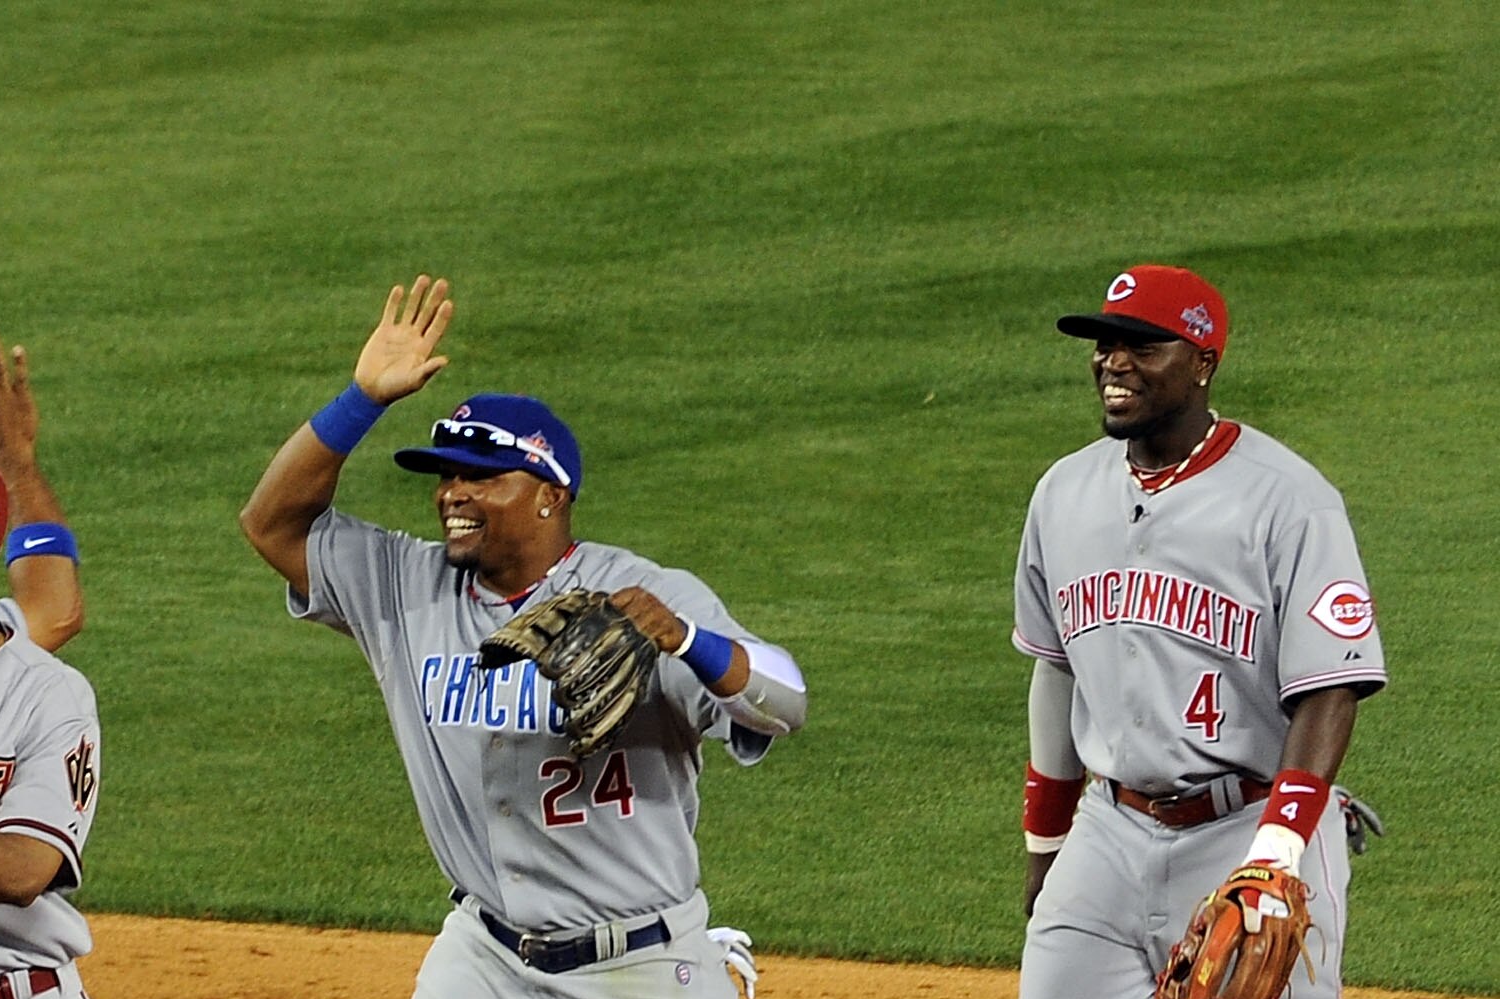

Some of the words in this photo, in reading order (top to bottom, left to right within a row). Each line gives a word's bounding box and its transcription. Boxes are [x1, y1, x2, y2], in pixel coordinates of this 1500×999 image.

[1107, 272, 1137, 302] C
[1056, 568, 1260, 664] CINCINNATI
[1183, 669, 1227, 743] 4
[538, 749, 636, 829] 24
[1280, 801, 1299, 821] 4
